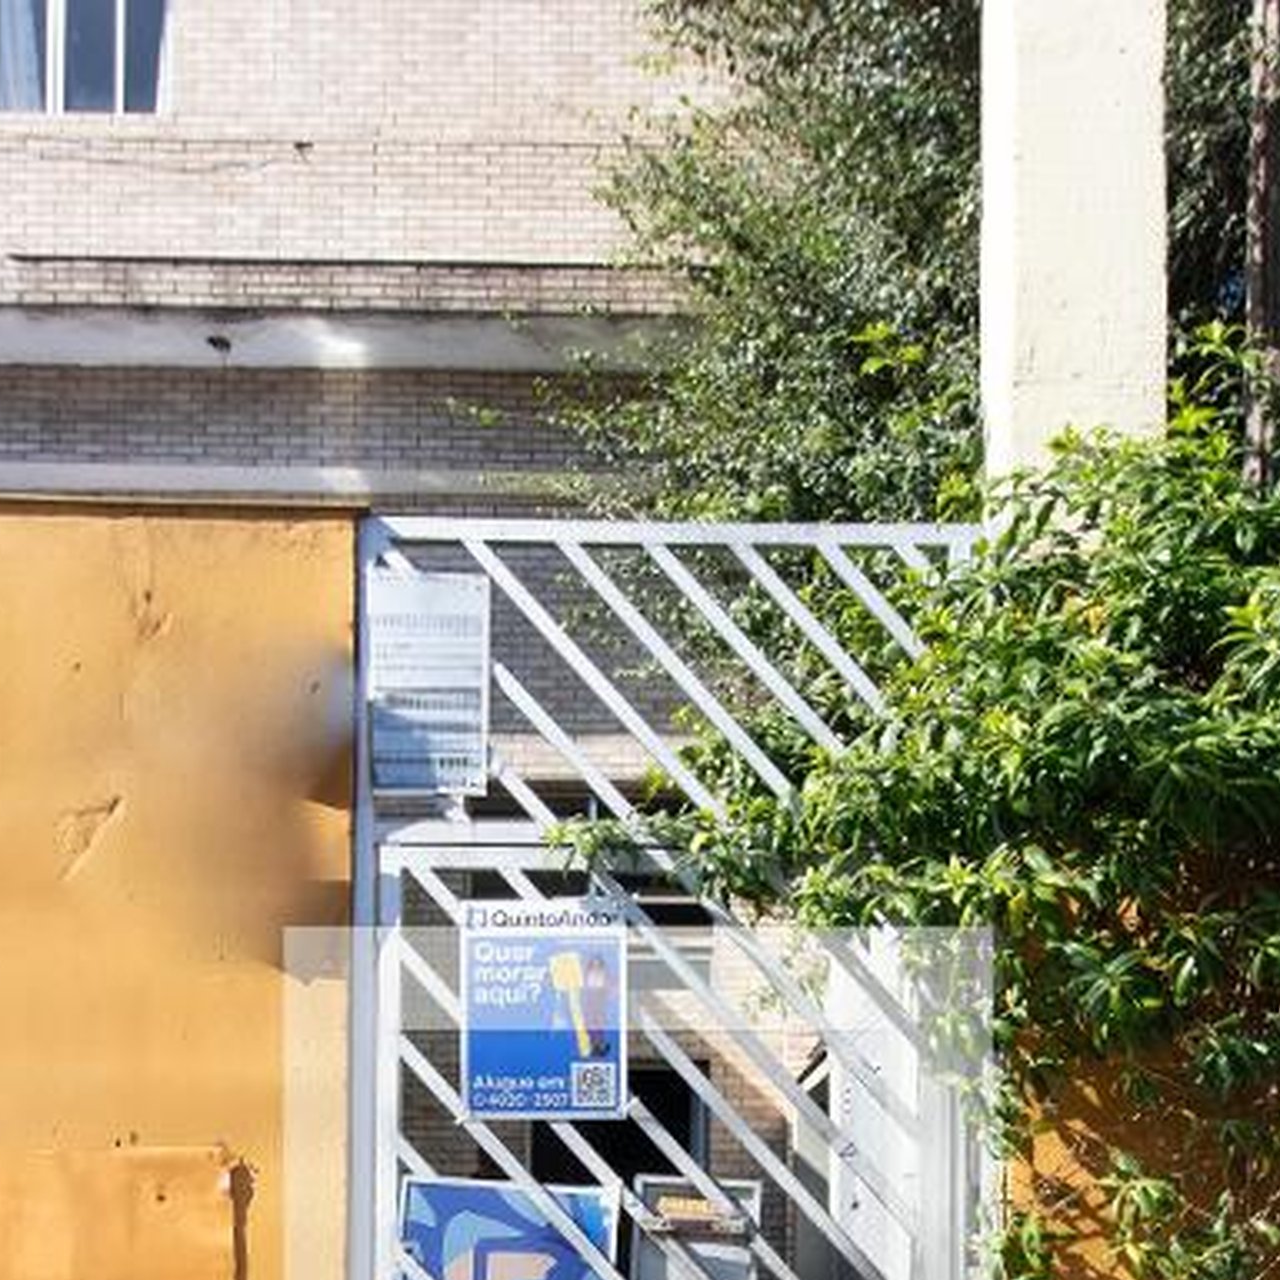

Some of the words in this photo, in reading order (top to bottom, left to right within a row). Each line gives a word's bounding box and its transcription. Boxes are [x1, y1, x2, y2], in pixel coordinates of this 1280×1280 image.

[475, 941, 532, 962] Quer
[474, 966, 547, 983] morar
[474, 983, 541, 1008] aqui?
